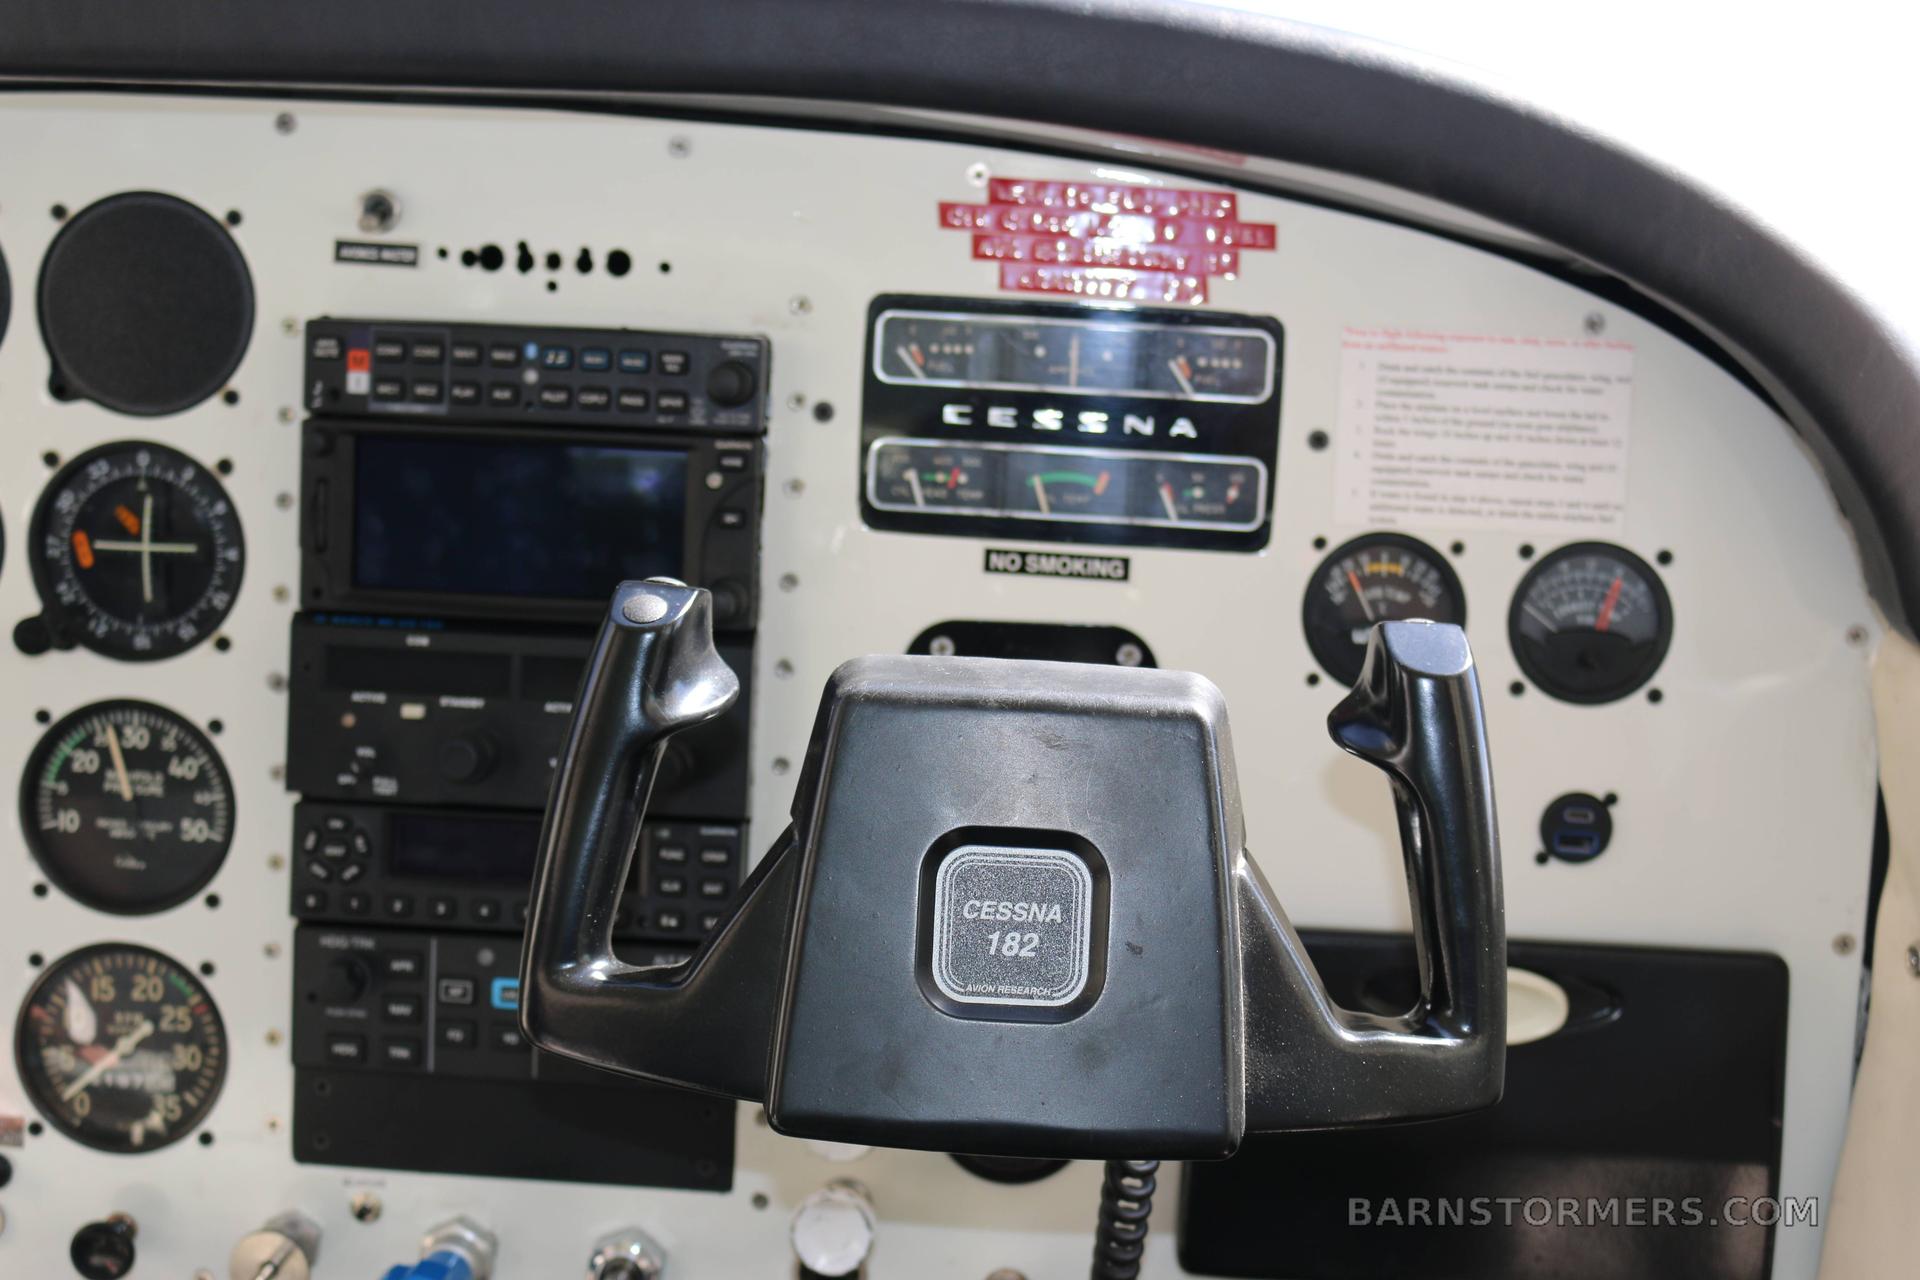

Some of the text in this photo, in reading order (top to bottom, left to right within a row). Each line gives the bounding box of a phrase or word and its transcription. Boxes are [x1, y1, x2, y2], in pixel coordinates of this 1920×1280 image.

[942, 404, 1198, 438] CESSNA
[988, 551, 1125, 579] NO SMOKING
[121, 728, 151, 750] 30
[71, 751, 101, 775] 20
[168, 757, 199, 780] 40
[57, 808, 80, 833] 10
[180, 817, 209, 843] 50
[963, 900, 1063, 924] CESSNA
[988, 930, 1040, 958] 182
[90, 979, 116, 1003] 15
[131, 976, 165, 1003] 20
[965, 984, 1053, 997] AVION RESEARCH
[159, 1005, 193, 1033] 25
[172, 1044, 202, 1072] 30
[74, 1092, 90, 1117] 0
[152, 1093, 182, 1121] 35
